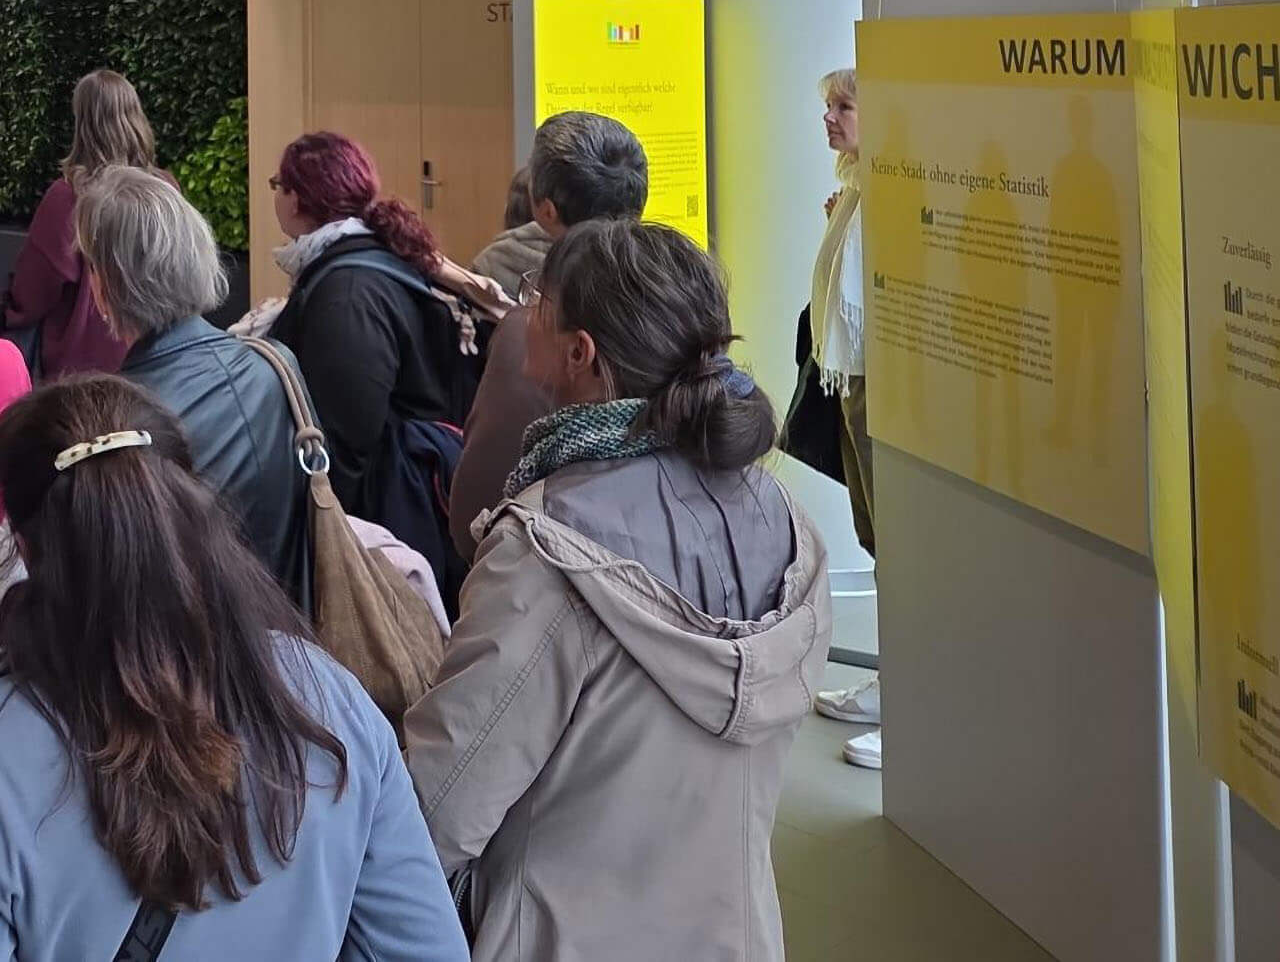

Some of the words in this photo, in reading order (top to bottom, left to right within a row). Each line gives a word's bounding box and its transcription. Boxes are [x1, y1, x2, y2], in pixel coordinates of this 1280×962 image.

[487, 2, 513, 23] ST
[999, 39, 1127, 77] WARUM
[1182, 43, 1280, 102] WICH
[870, 156, 899, 177] Keine
[900, 158, 928, 181] Stadt
[929, 163, 957, 185] ohne
[959, 169, 996, 193] eigene
[999, 171, 1050, 198] Statistik
